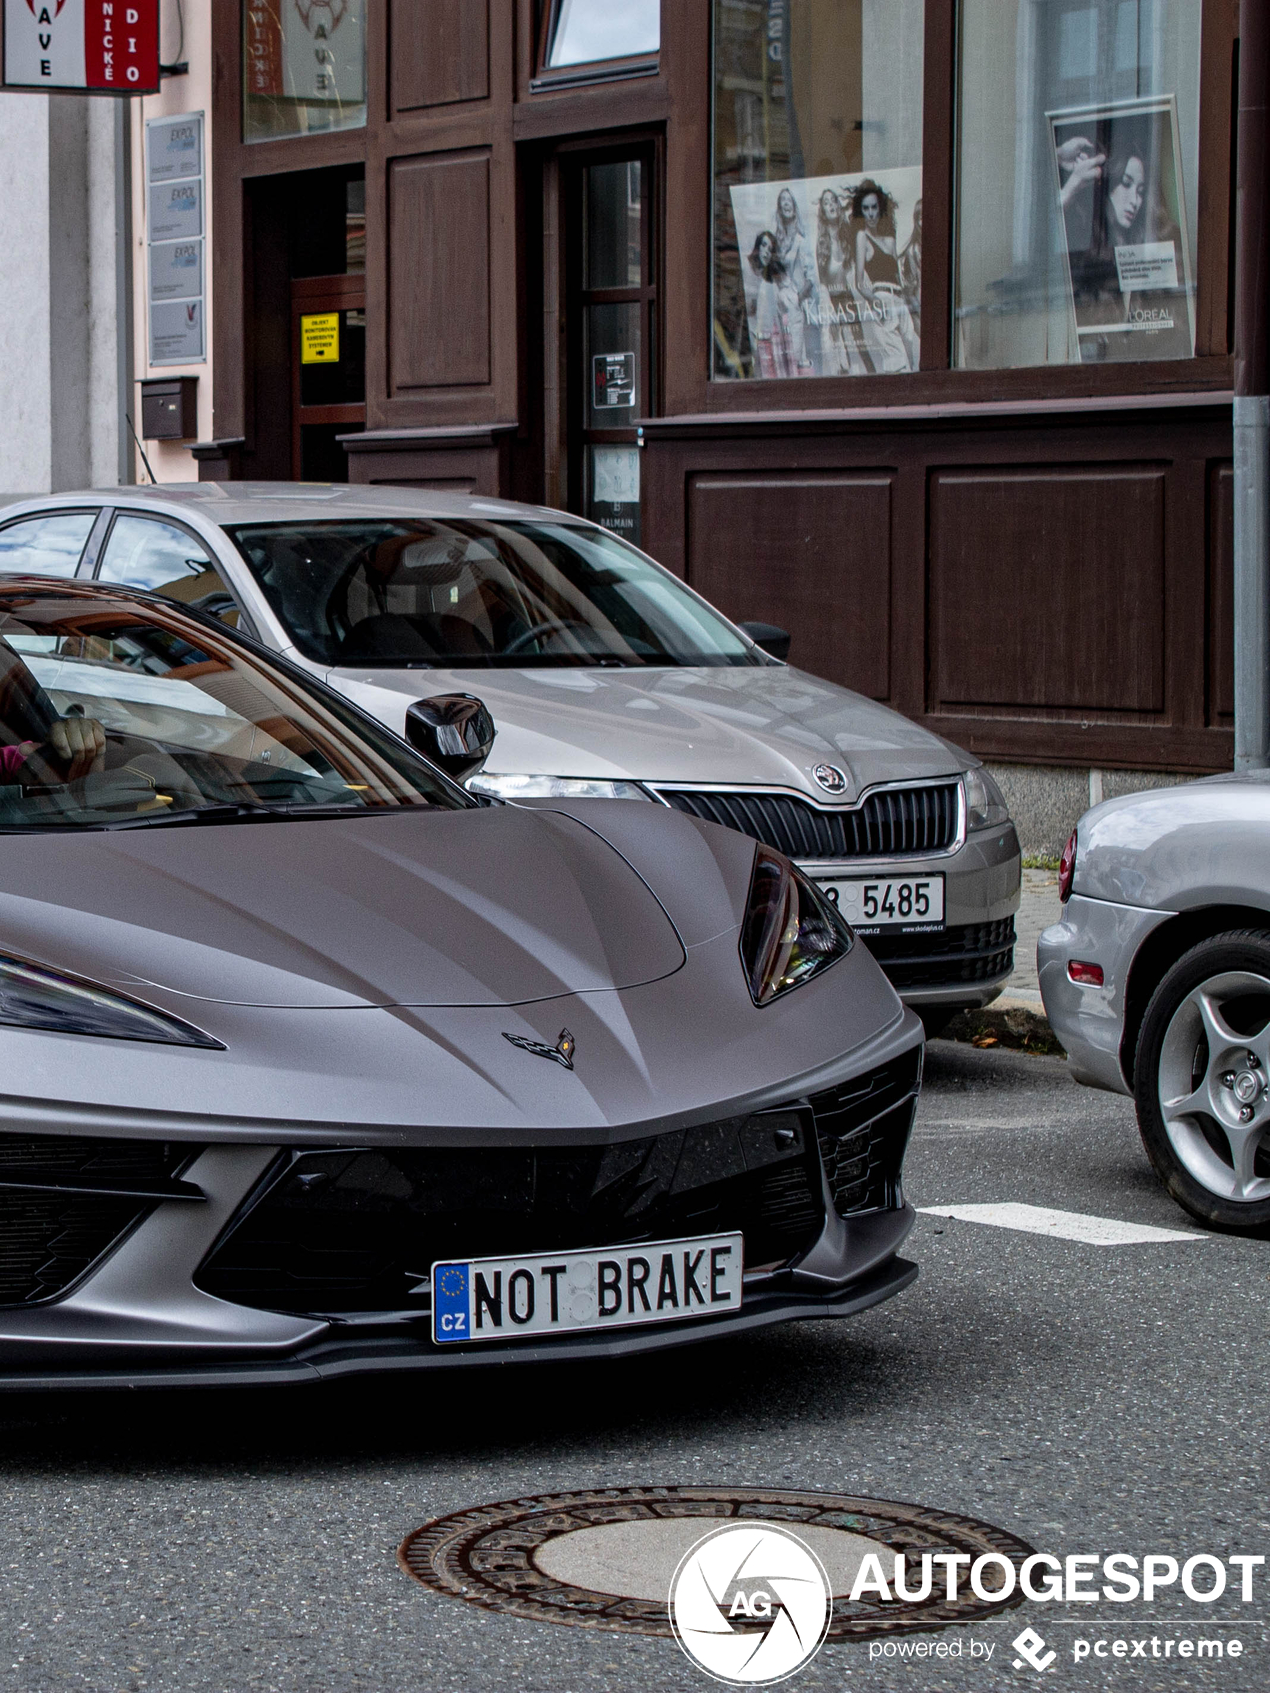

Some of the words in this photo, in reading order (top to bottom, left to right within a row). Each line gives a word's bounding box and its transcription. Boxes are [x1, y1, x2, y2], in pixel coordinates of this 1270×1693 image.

[863, 882, 930, 918] 5485
[474, 1264, 567, 1329] NOT
[597, 1245, 732, 1318] BRAKE
[441, 1313, 466, 1331] CZ
